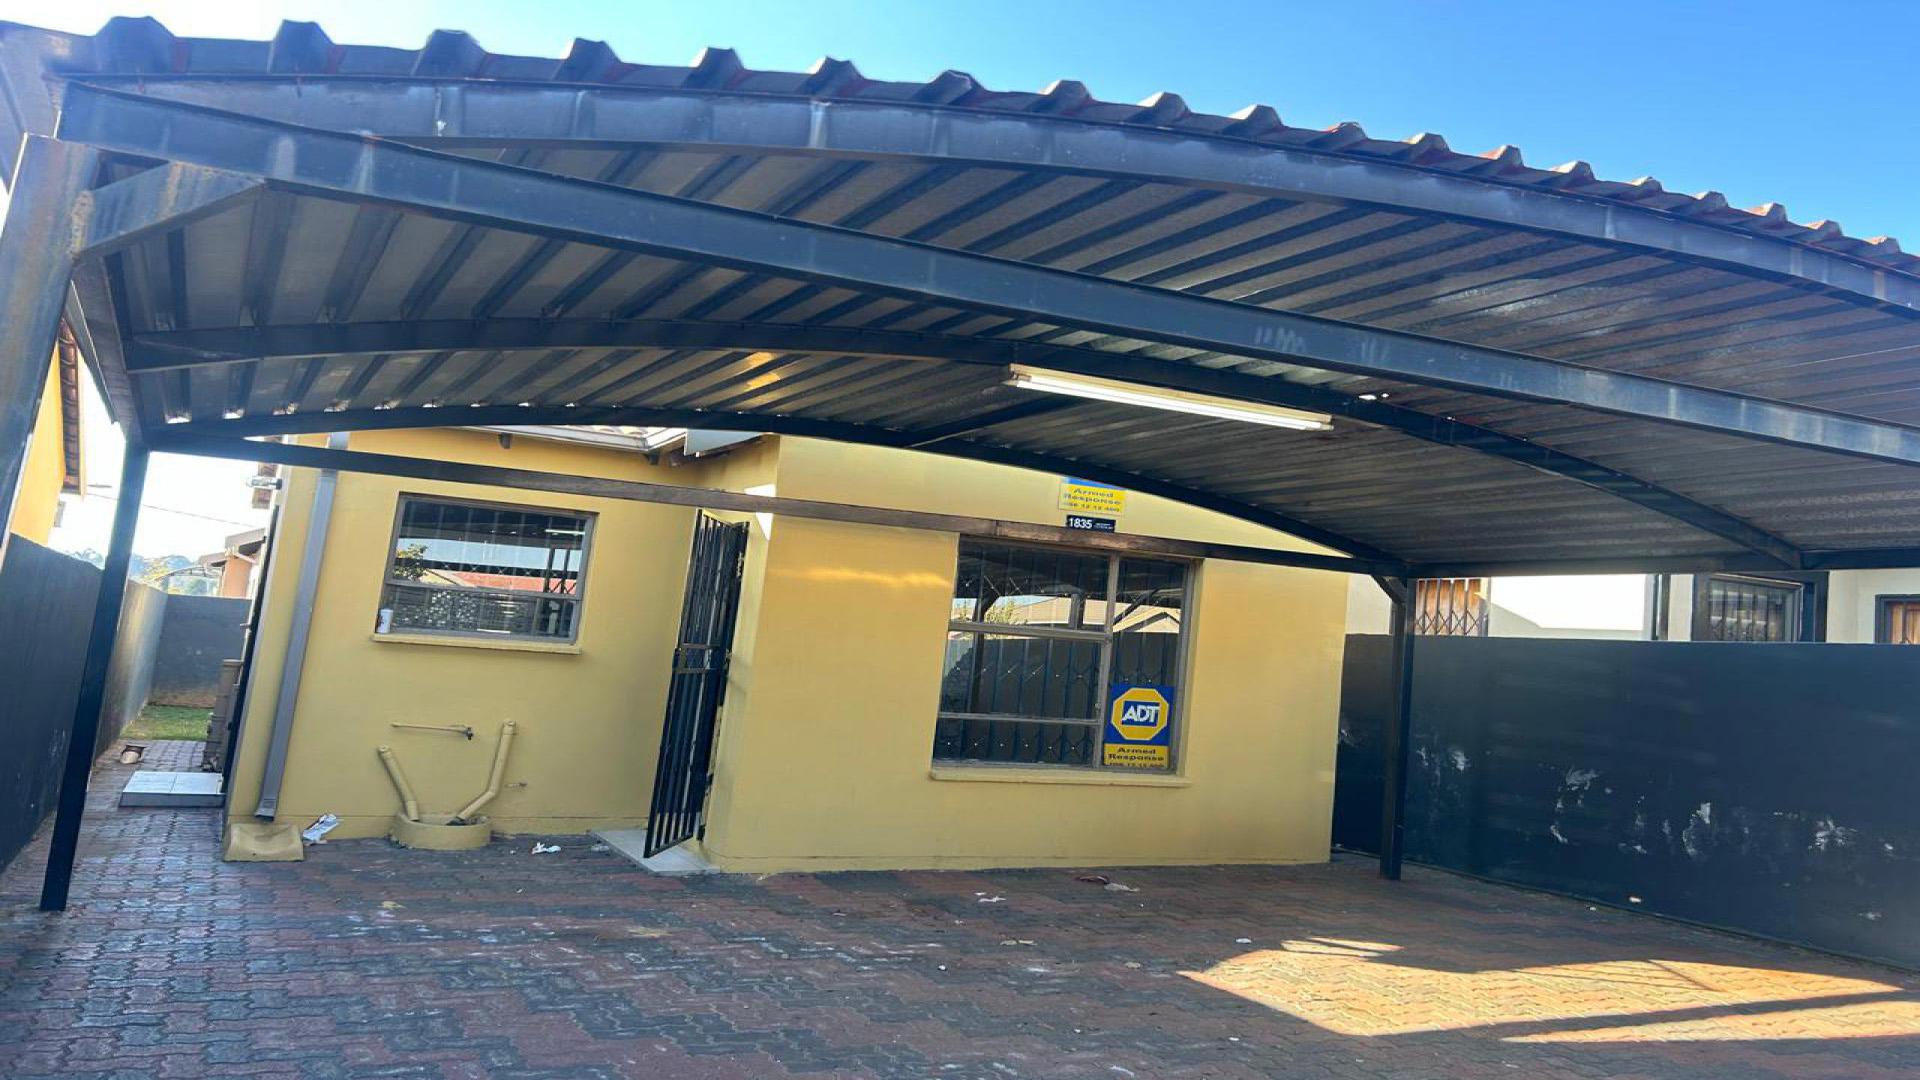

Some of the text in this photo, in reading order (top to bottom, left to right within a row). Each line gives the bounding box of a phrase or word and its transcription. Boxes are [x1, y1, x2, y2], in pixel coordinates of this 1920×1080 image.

[1064, 493, 1121, 504] Response
[1073, 488, 1114, 498] Armed
[1069, 517, 1093, 529] 1835
[1121, 704, 1160, 723] ADT
[1108, 753, 1165, 761] Response
